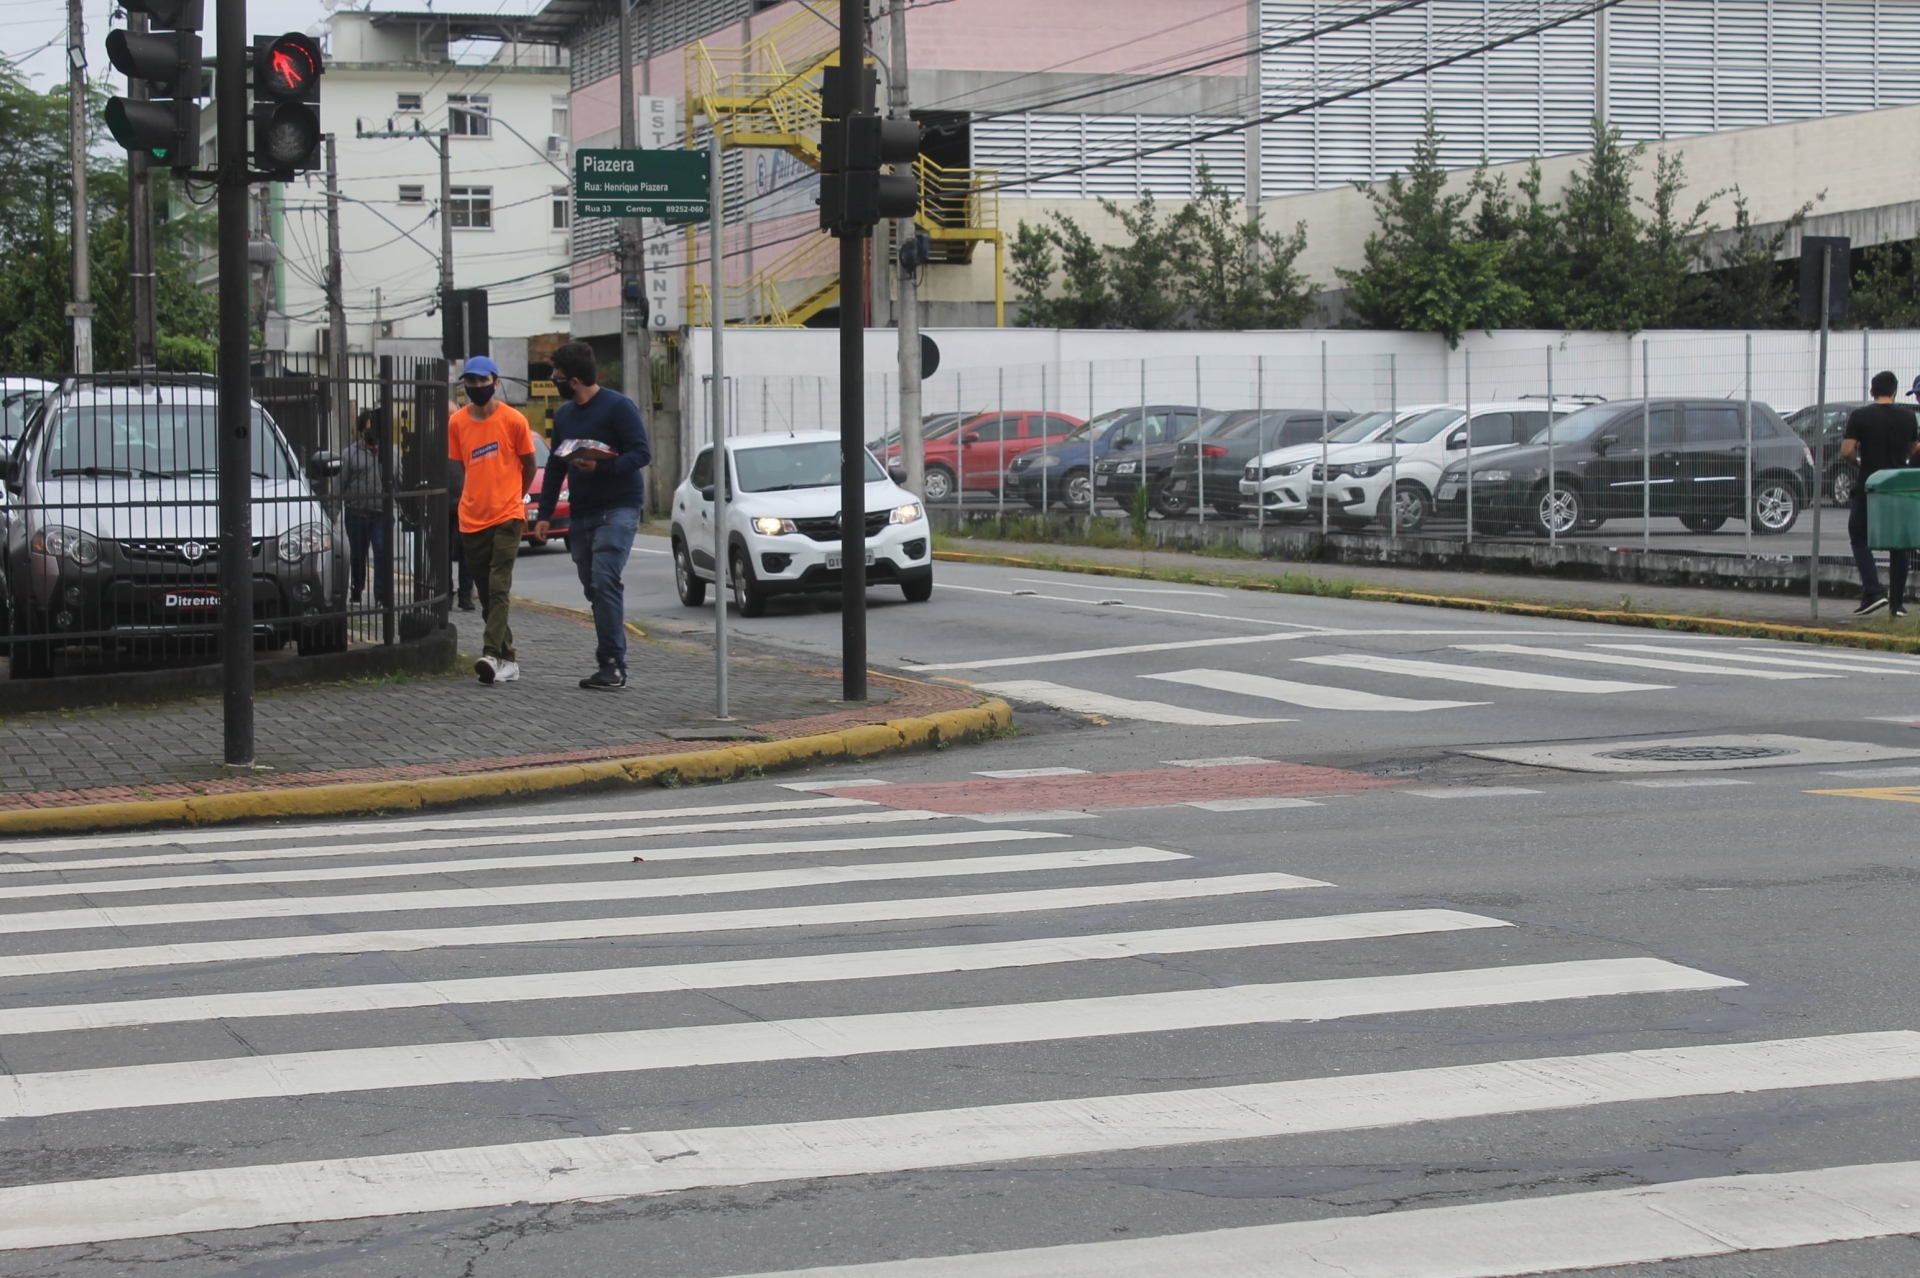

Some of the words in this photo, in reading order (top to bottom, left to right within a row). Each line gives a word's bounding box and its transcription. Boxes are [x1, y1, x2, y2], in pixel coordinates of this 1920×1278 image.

[583, 156, 635, 172] Piazera
[584, 182, 602, 191] Rua:
[604, 182, 639, 193] Henrique
[640, 182, 669, 191] Piazera
[626, 205, 652, 213] Centro
[666, 205, 704, 213] 89252-060
[650, 99, 670, 327] ESTAMENTO
[187, 546, 198, 555] FAT
